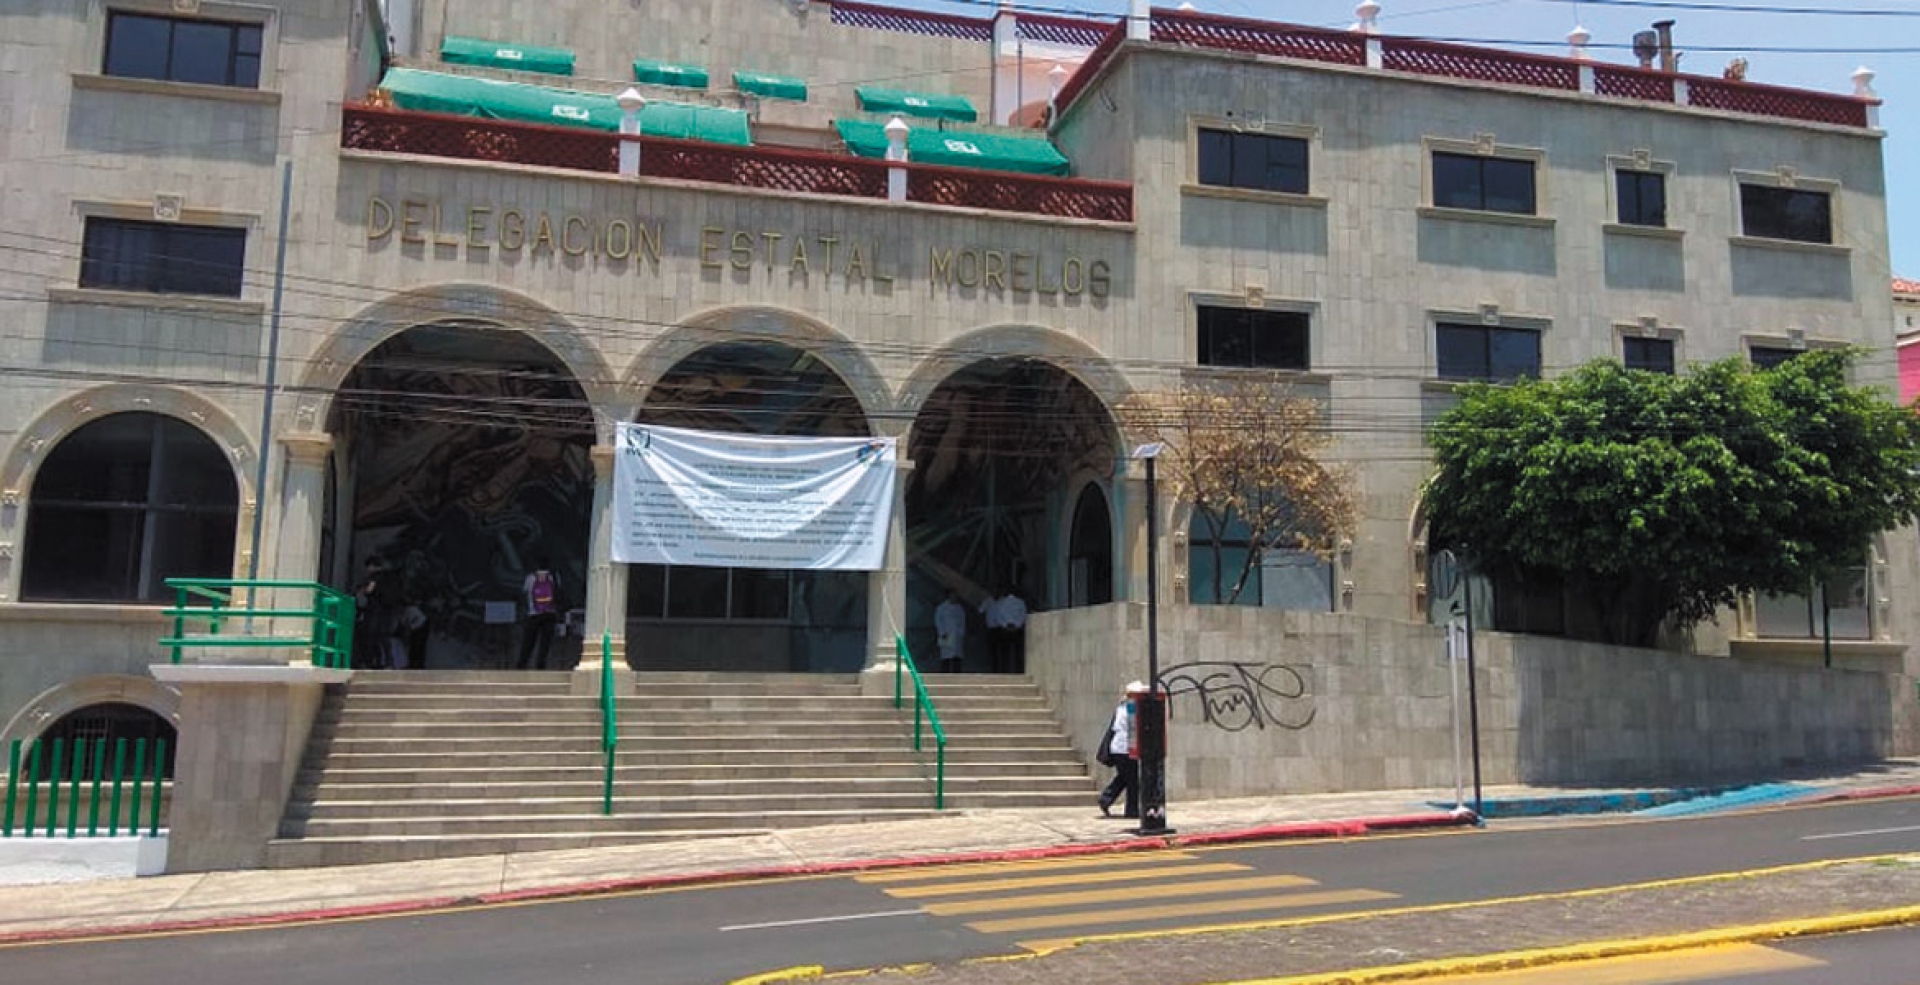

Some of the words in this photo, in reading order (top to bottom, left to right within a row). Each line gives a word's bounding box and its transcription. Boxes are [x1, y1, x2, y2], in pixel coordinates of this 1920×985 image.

[366, 195, 663, 263] DELEGACION
[701, 225, 894, 283] ESTATAL
[928, 245, 1112, 299] MORELOS
